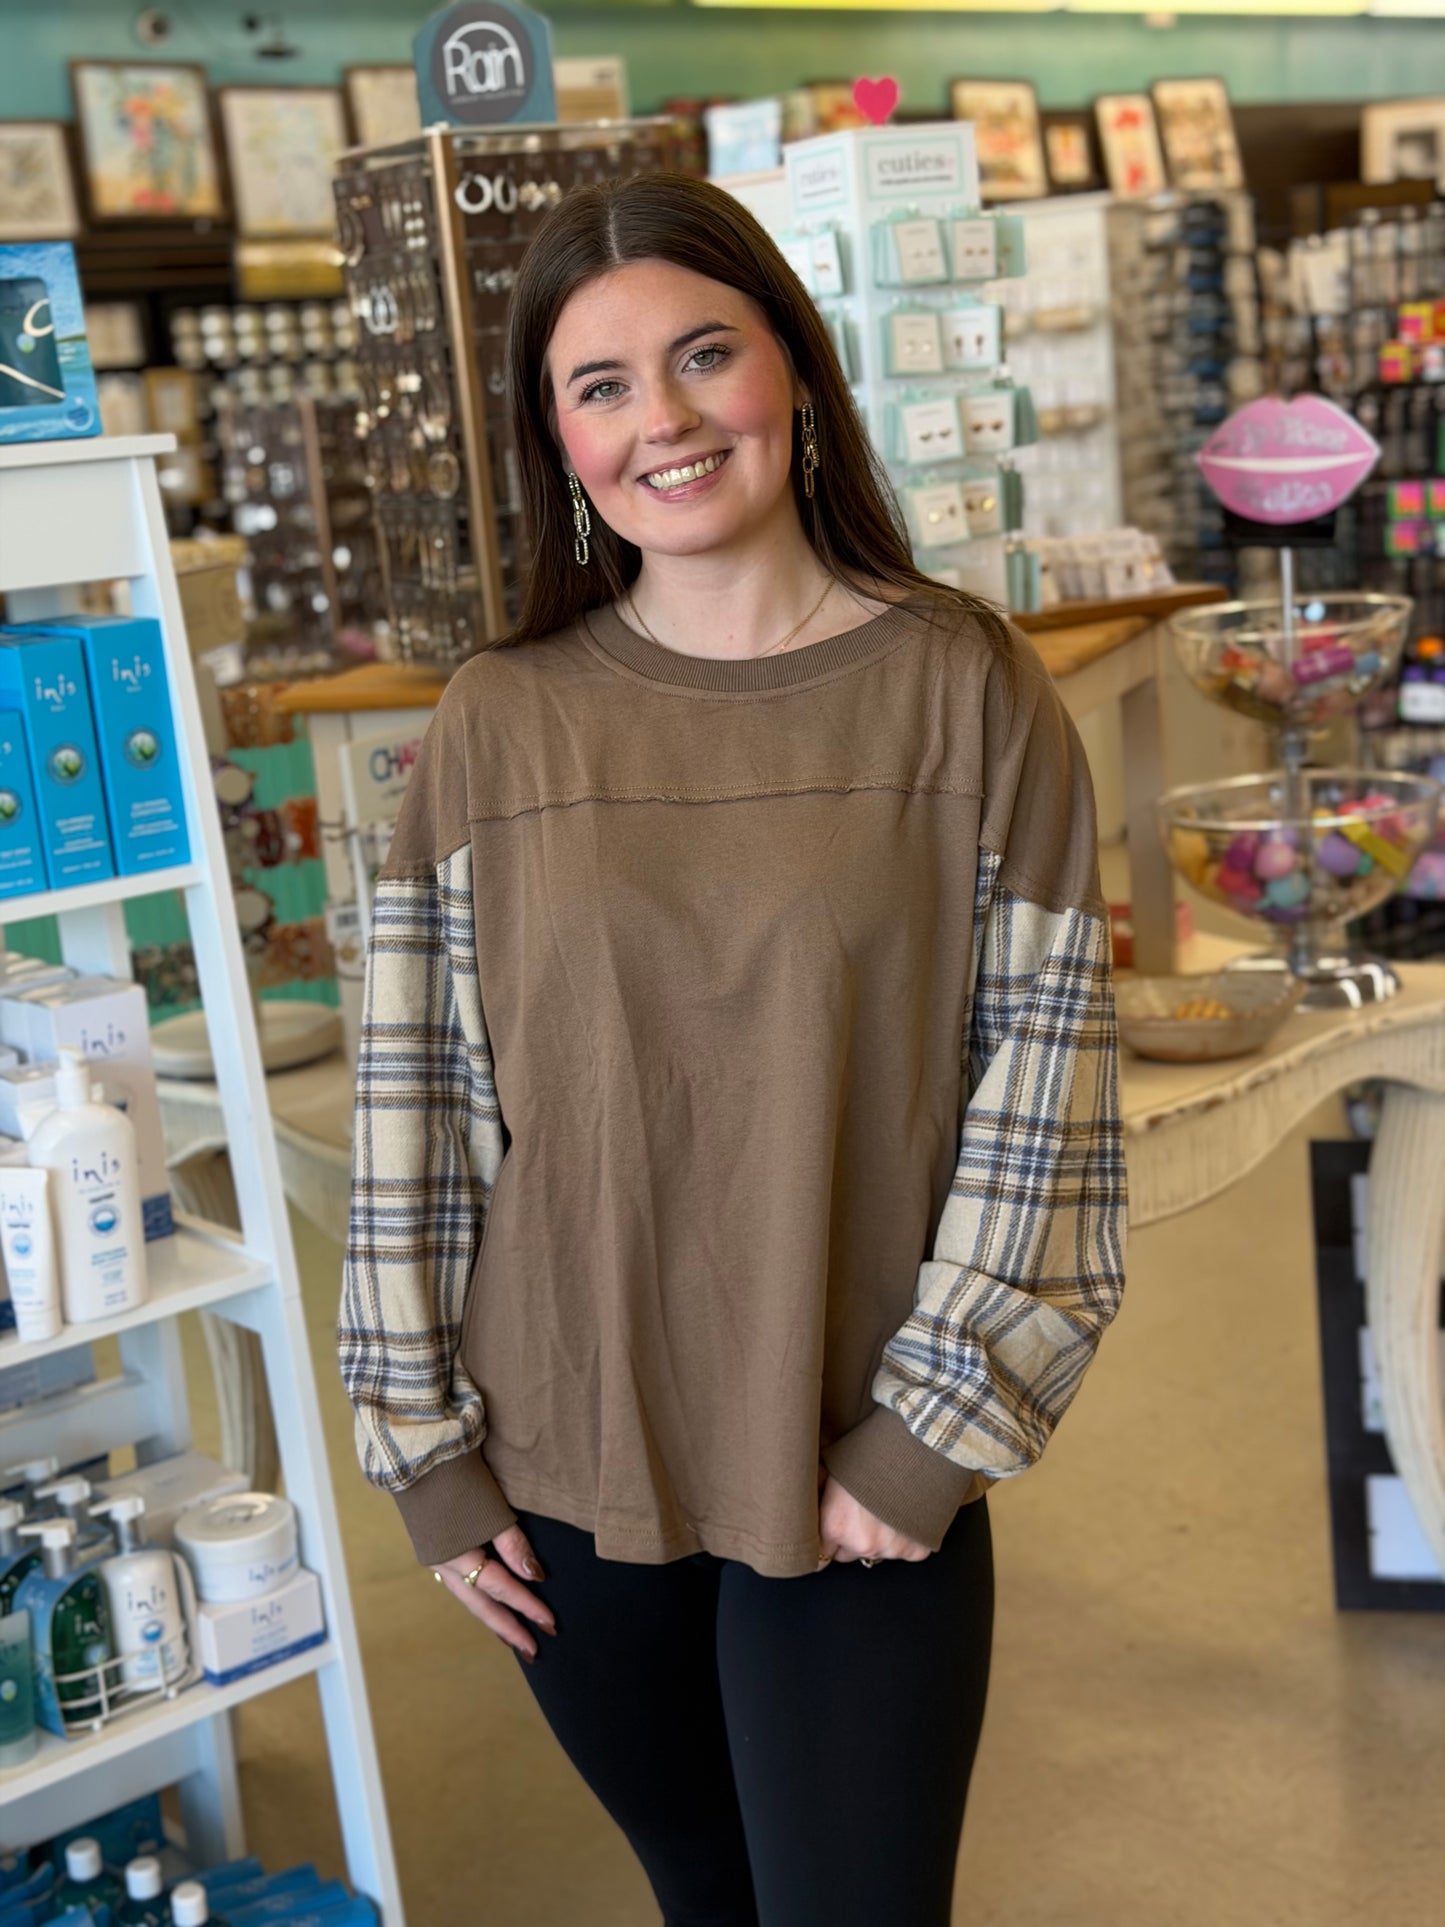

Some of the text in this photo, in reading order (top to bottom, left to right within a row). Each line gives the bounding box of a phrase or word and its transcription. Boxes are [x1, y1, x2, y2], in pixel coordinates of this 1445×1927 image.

[443, 40, 524, 95] Rain
[878, 149, 945, 175] cuties
[112, 655, 151, 685] inis
[34, 673, 76, 705] inis
[80, 1022, 126, 1055] inis
[72, 1151, 120, 1184] inis
[127, 1585, 166, 1613] inis
[252, 1601, 282, 1625] inis
